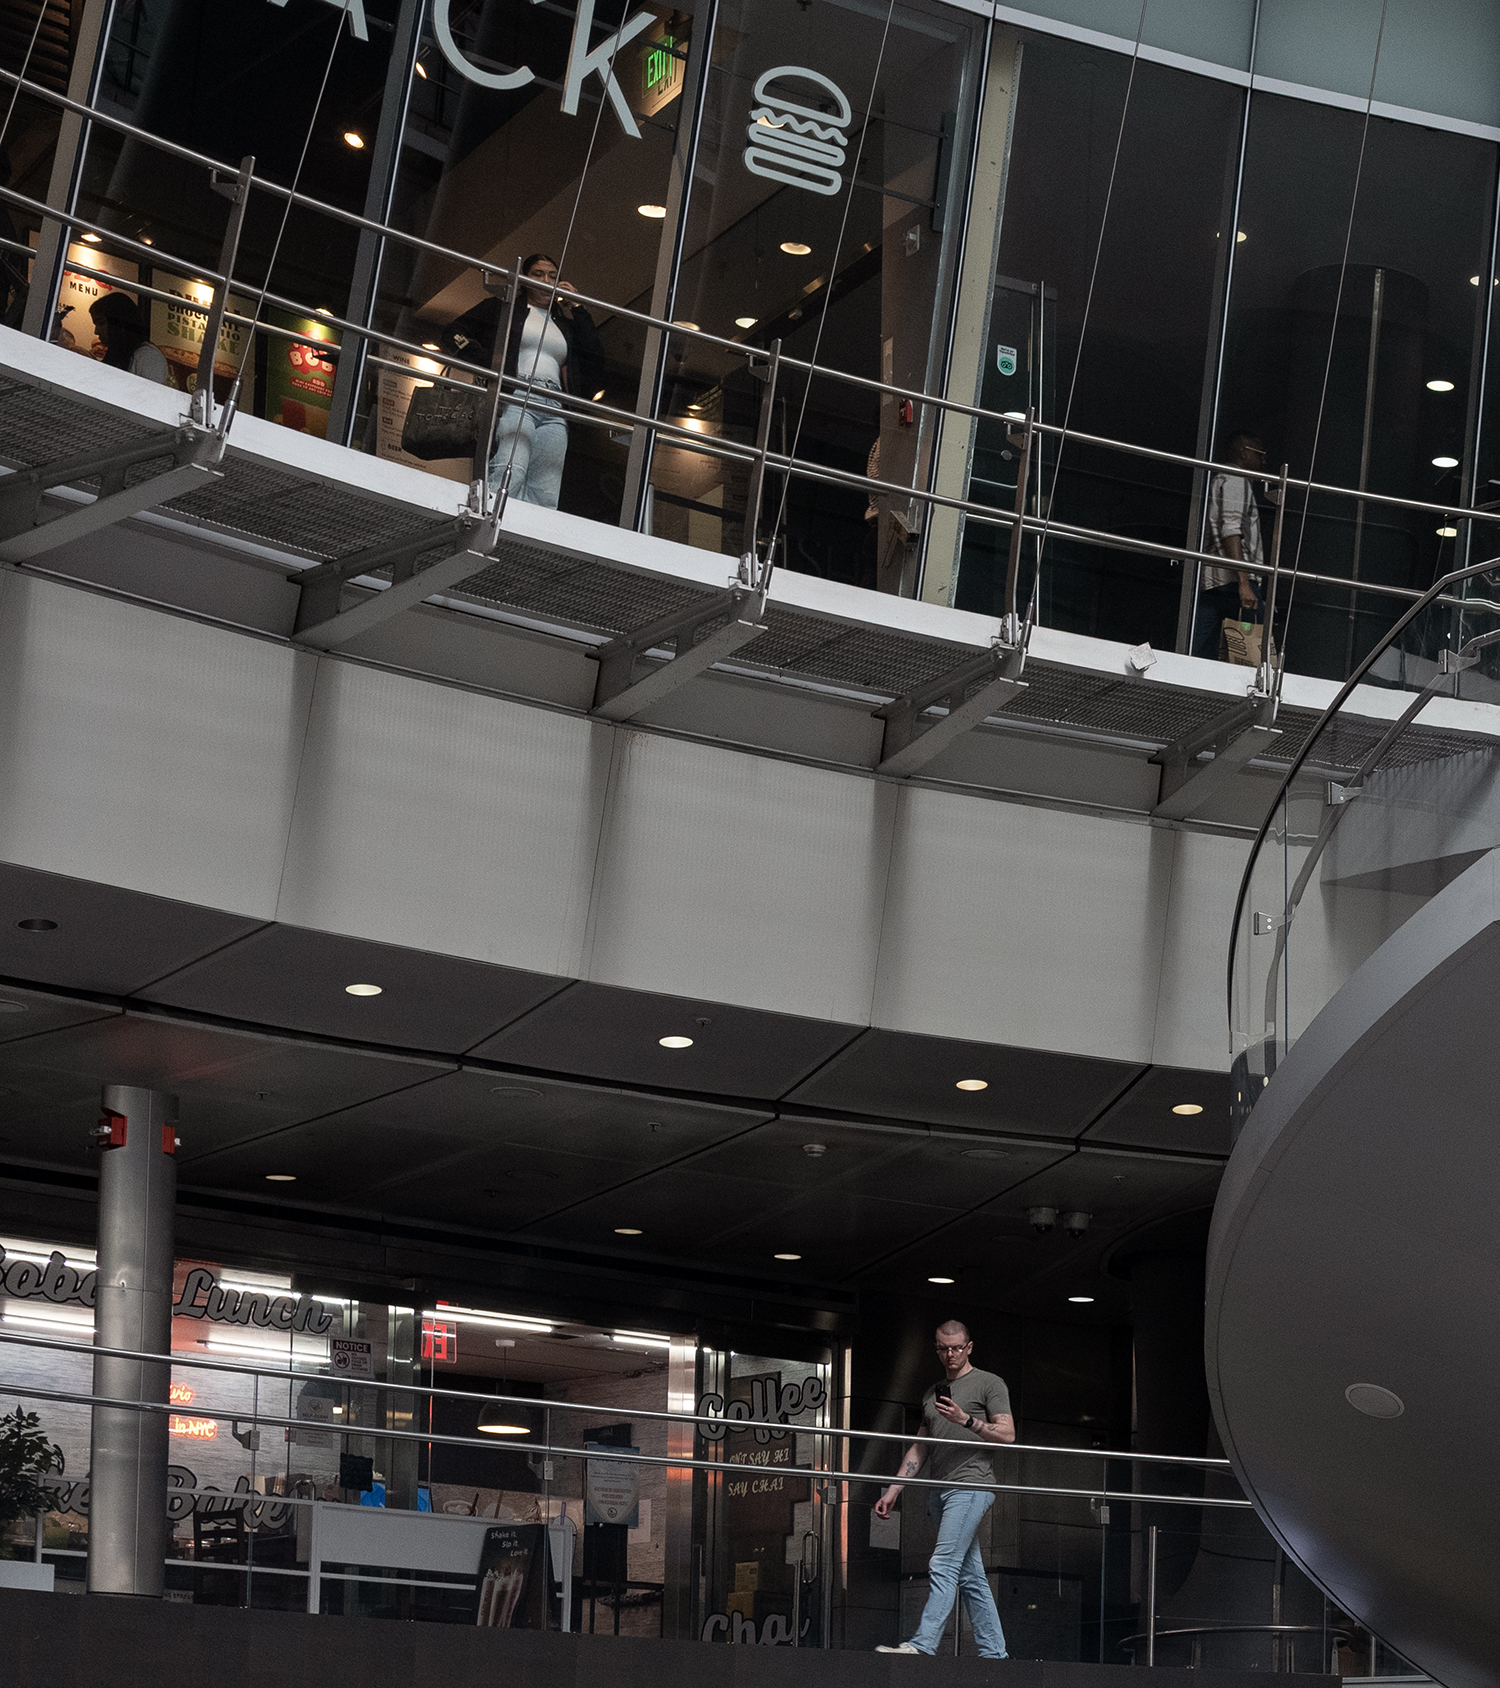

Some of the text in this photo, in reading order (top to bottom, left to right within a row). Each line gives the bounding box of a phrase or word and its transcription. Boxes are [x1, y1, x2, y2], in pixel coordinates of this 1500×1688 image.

[69, 281, 98, 297] MENU
[172, 1267, 333, 1334] Lunch
[335, 1340, 370, 1353] NOTICE
[696, 1376, 827, 1445] Coffee
[748, 1449, 772, 1467] SAY
[772, 1447, 790, 1463] HI
[728, 1476, 785, 1498] SAY CHAI
